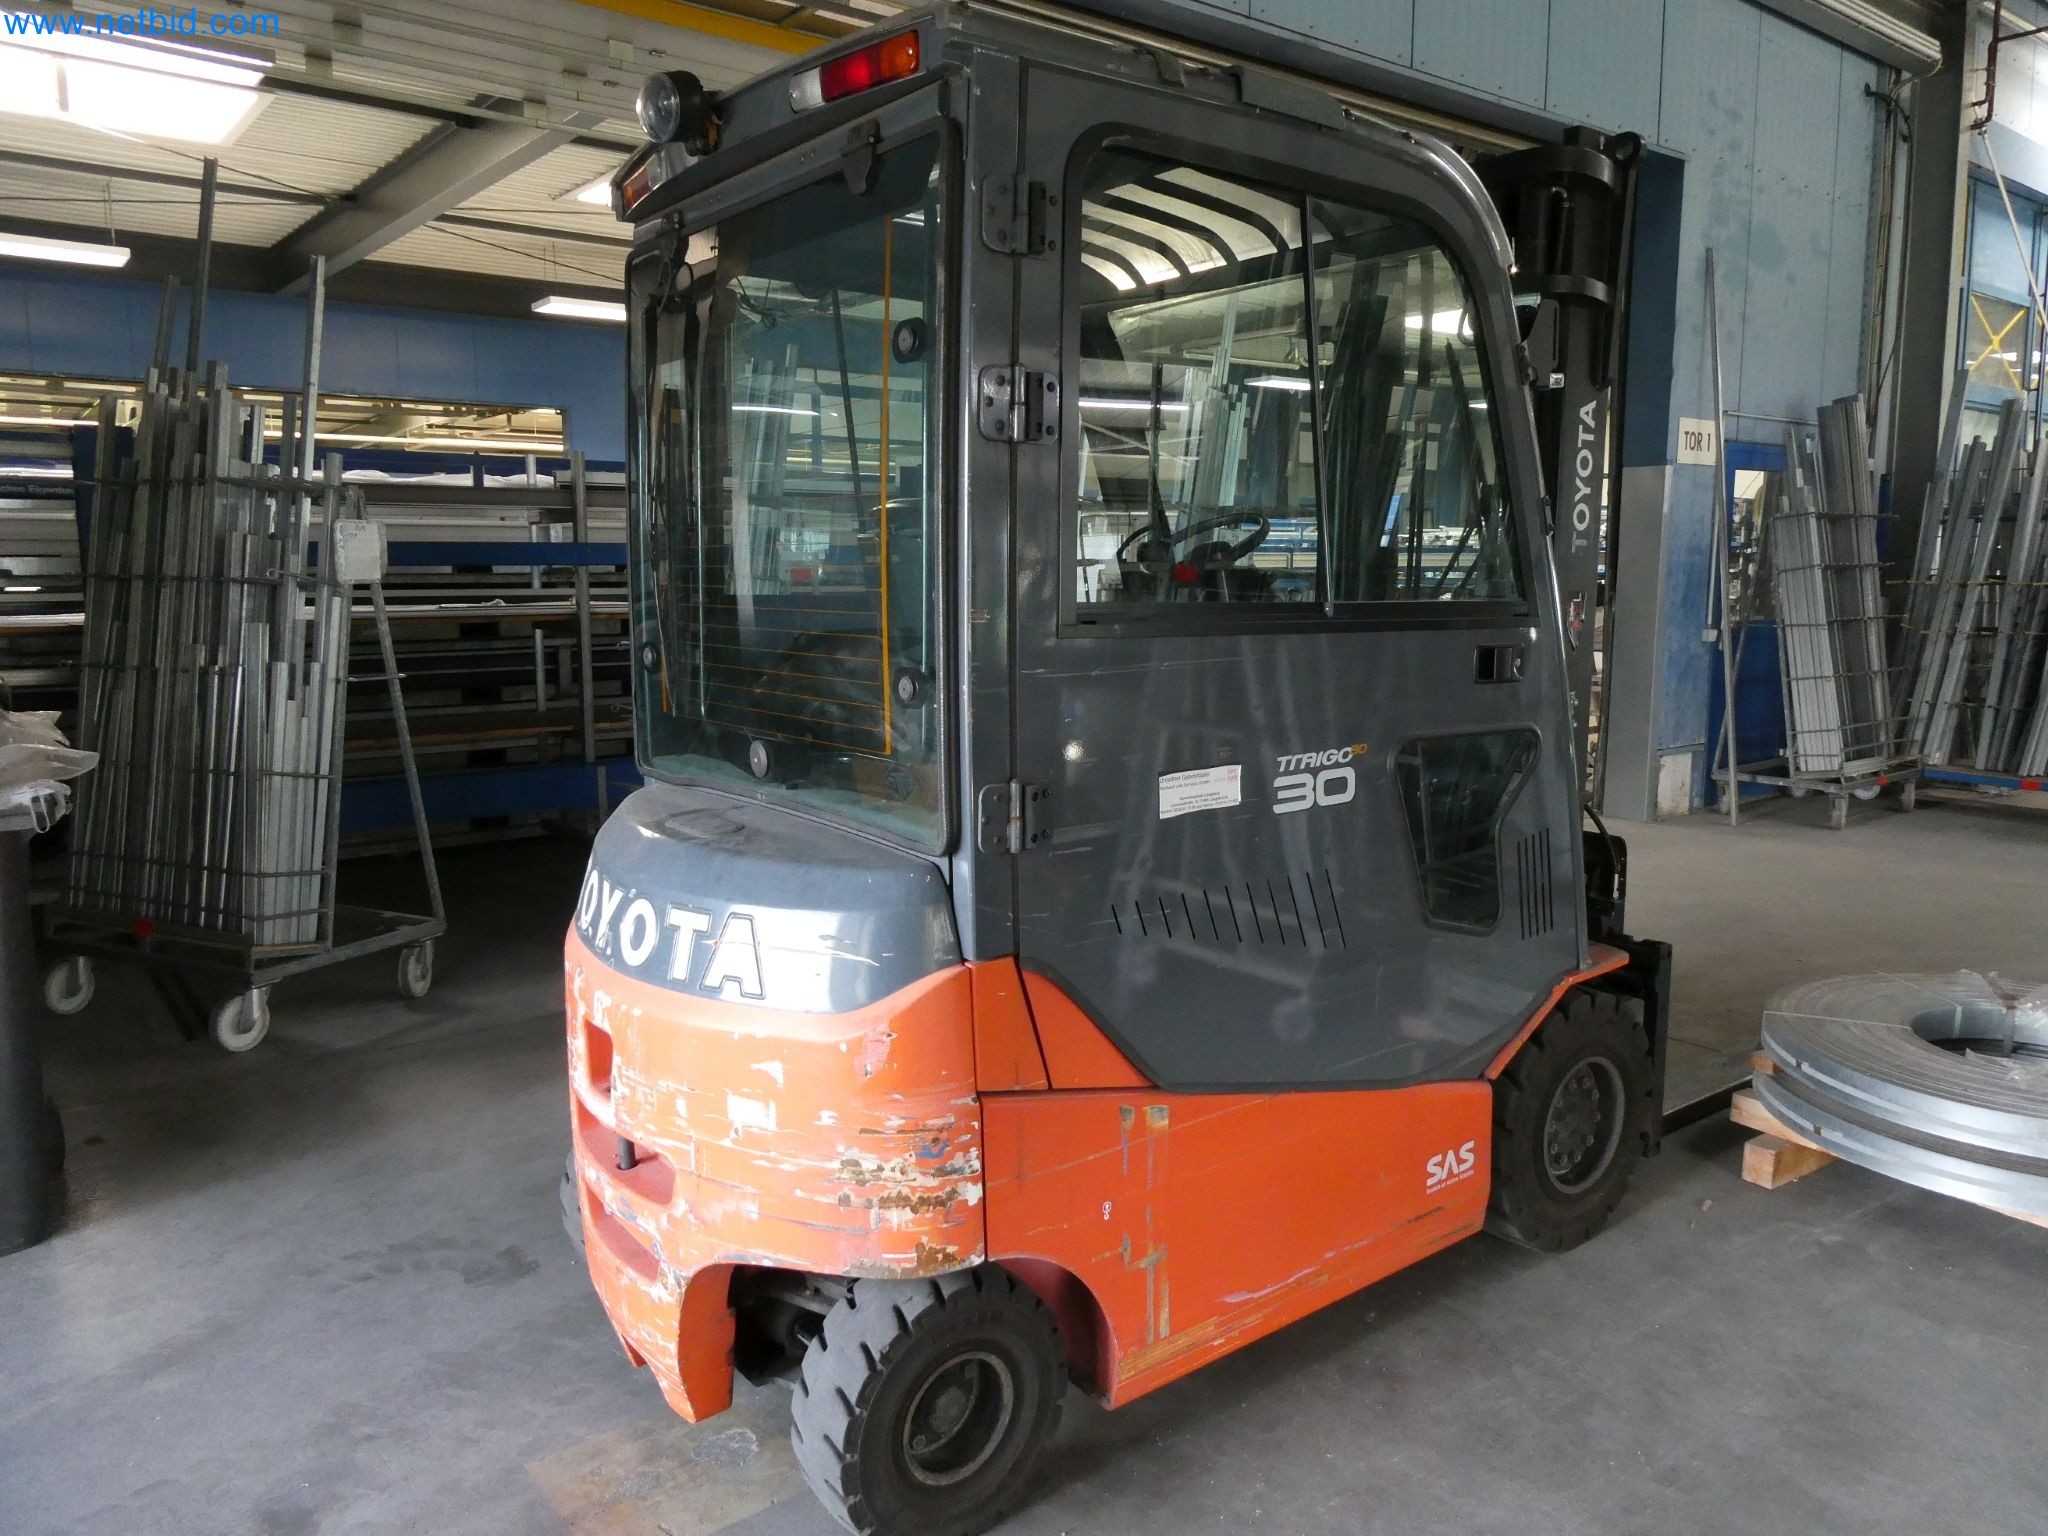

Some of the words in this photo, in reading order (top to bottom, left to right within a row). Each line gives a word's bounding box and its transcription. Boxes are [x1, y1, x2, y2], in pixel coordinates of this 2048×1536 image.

[1684, 430, 1703, 452] TOR
[1706, 433, 1711, 452] 1
[1572, 400, 1597, 553] TOYOTA
[1273, 766, 1356, 814] 30
[578, 868, 766, 1000] OYOTA
[1426, 1140, 1475, 1187] SAS
